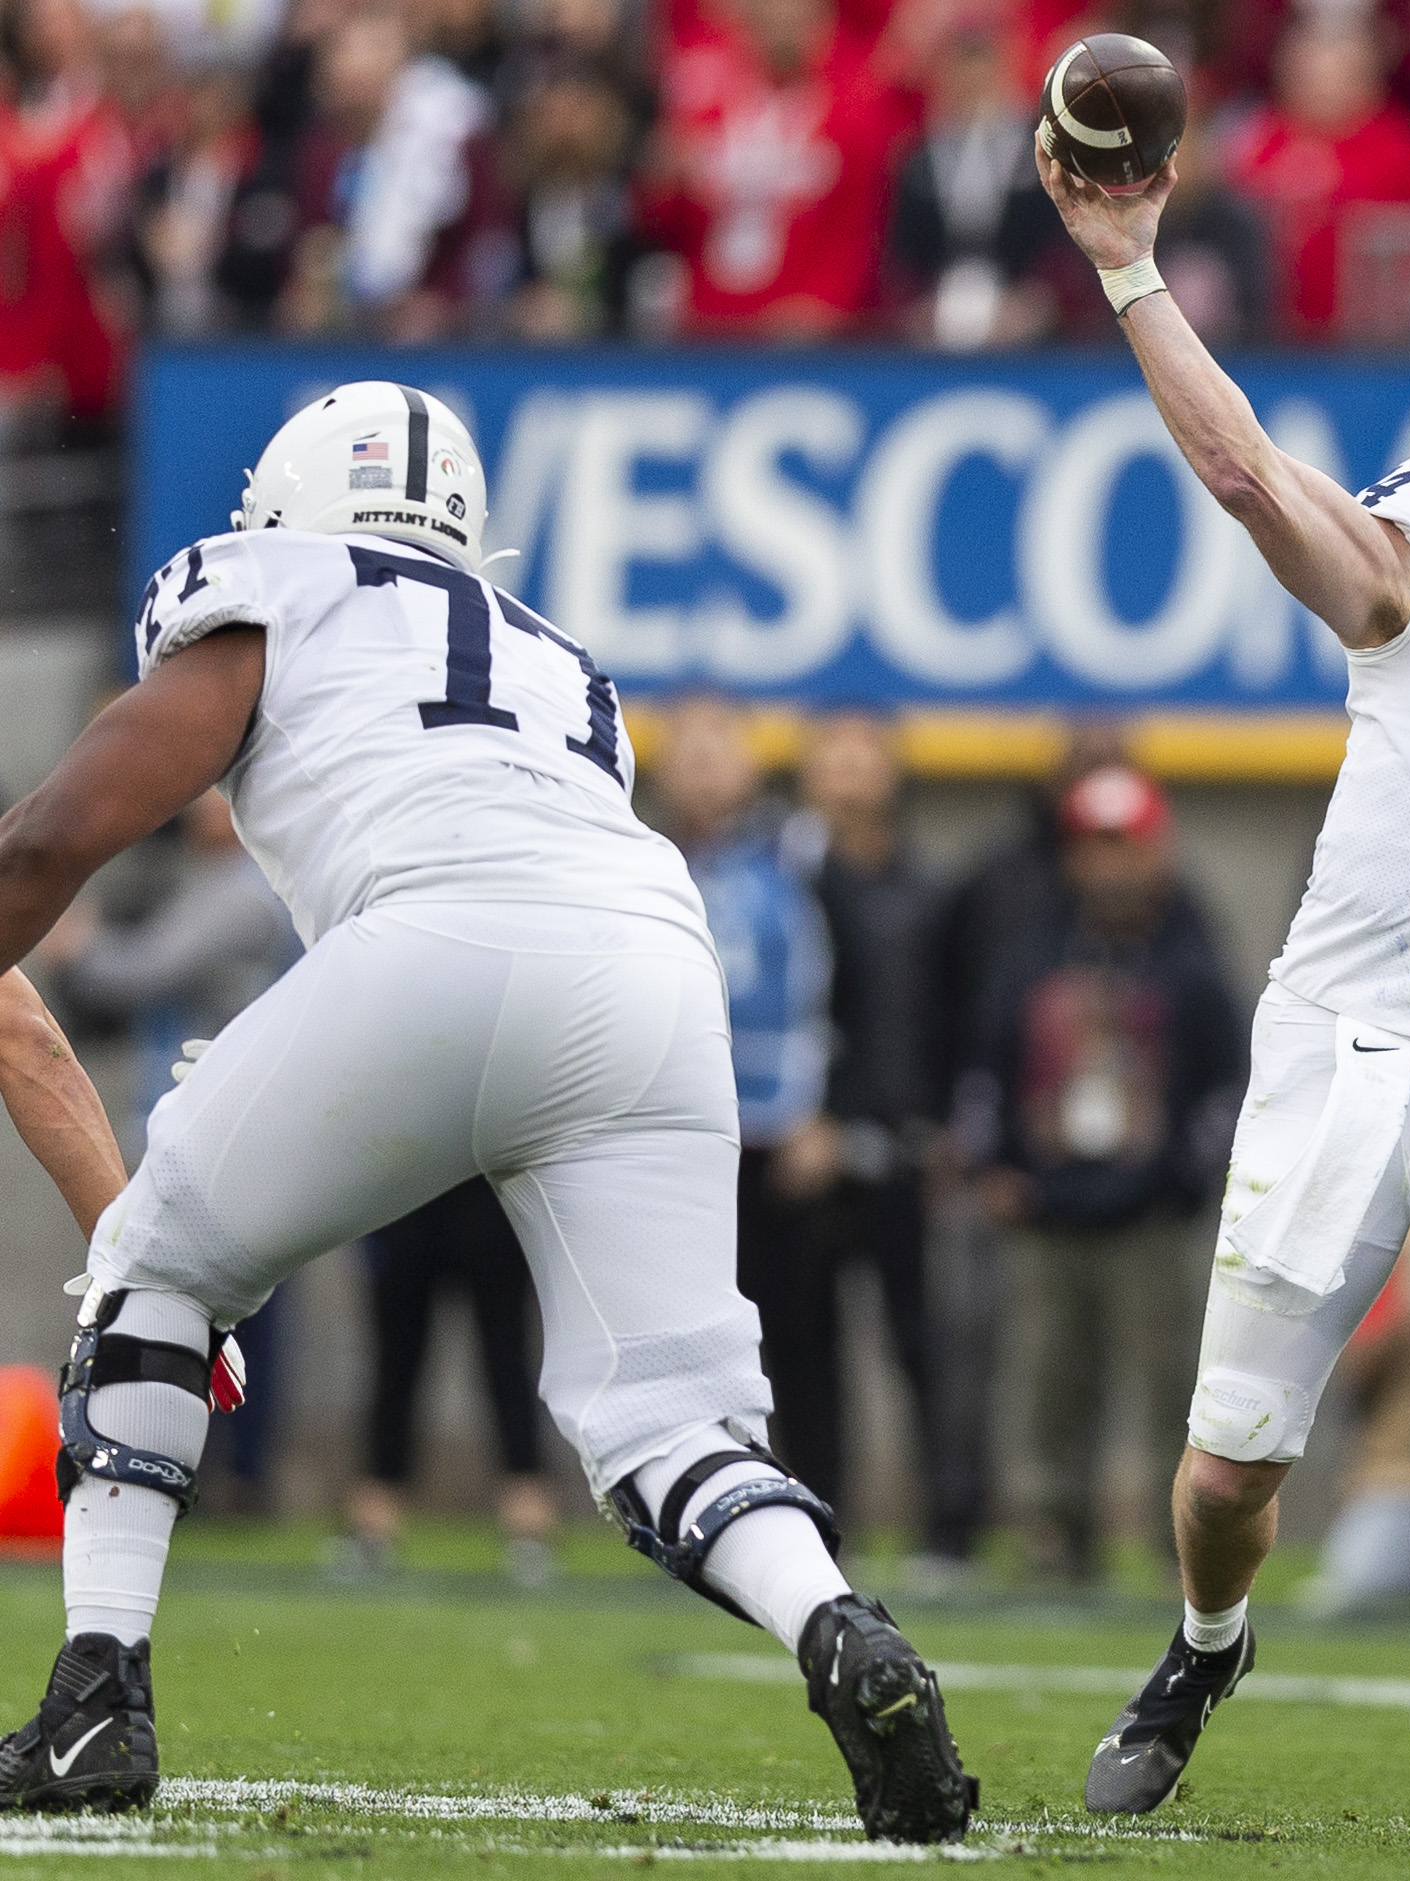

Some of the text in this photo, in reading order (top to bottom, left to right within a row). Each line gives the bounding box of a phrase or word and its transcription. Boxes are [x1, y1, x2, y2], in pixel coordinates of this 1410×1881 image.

[352, 511, 428, 528] NITTANY
[346, 544, 626, 791] 77
[1211, 1387, 1261, 1411] schutt
